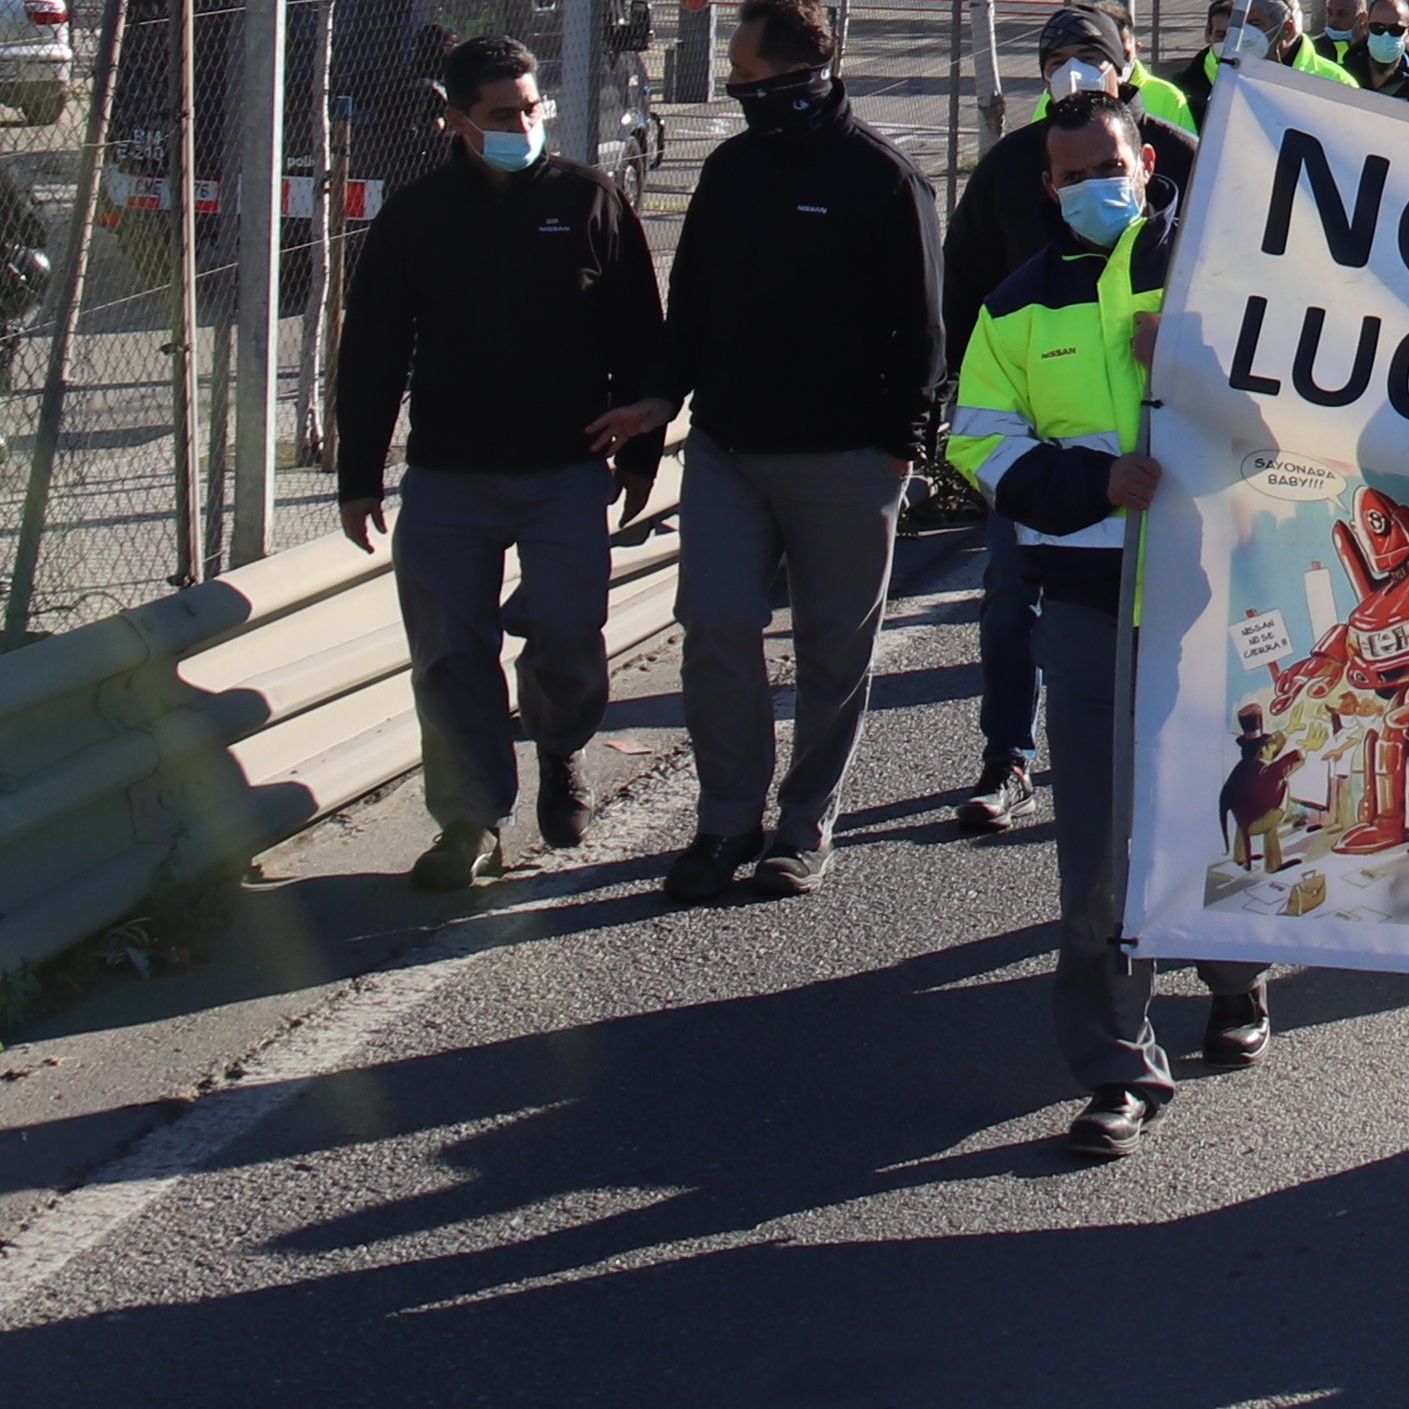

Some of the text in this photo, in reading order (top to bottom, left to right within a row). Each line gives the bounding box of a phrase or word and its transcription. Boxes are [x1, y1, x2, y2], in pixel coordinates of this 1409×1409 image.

[1040, 346, 1078, 360] NISSAN
[1254, 458, 1336, 480] SAYONARA
[1267, 474, 1324, 489] BABY!!!
